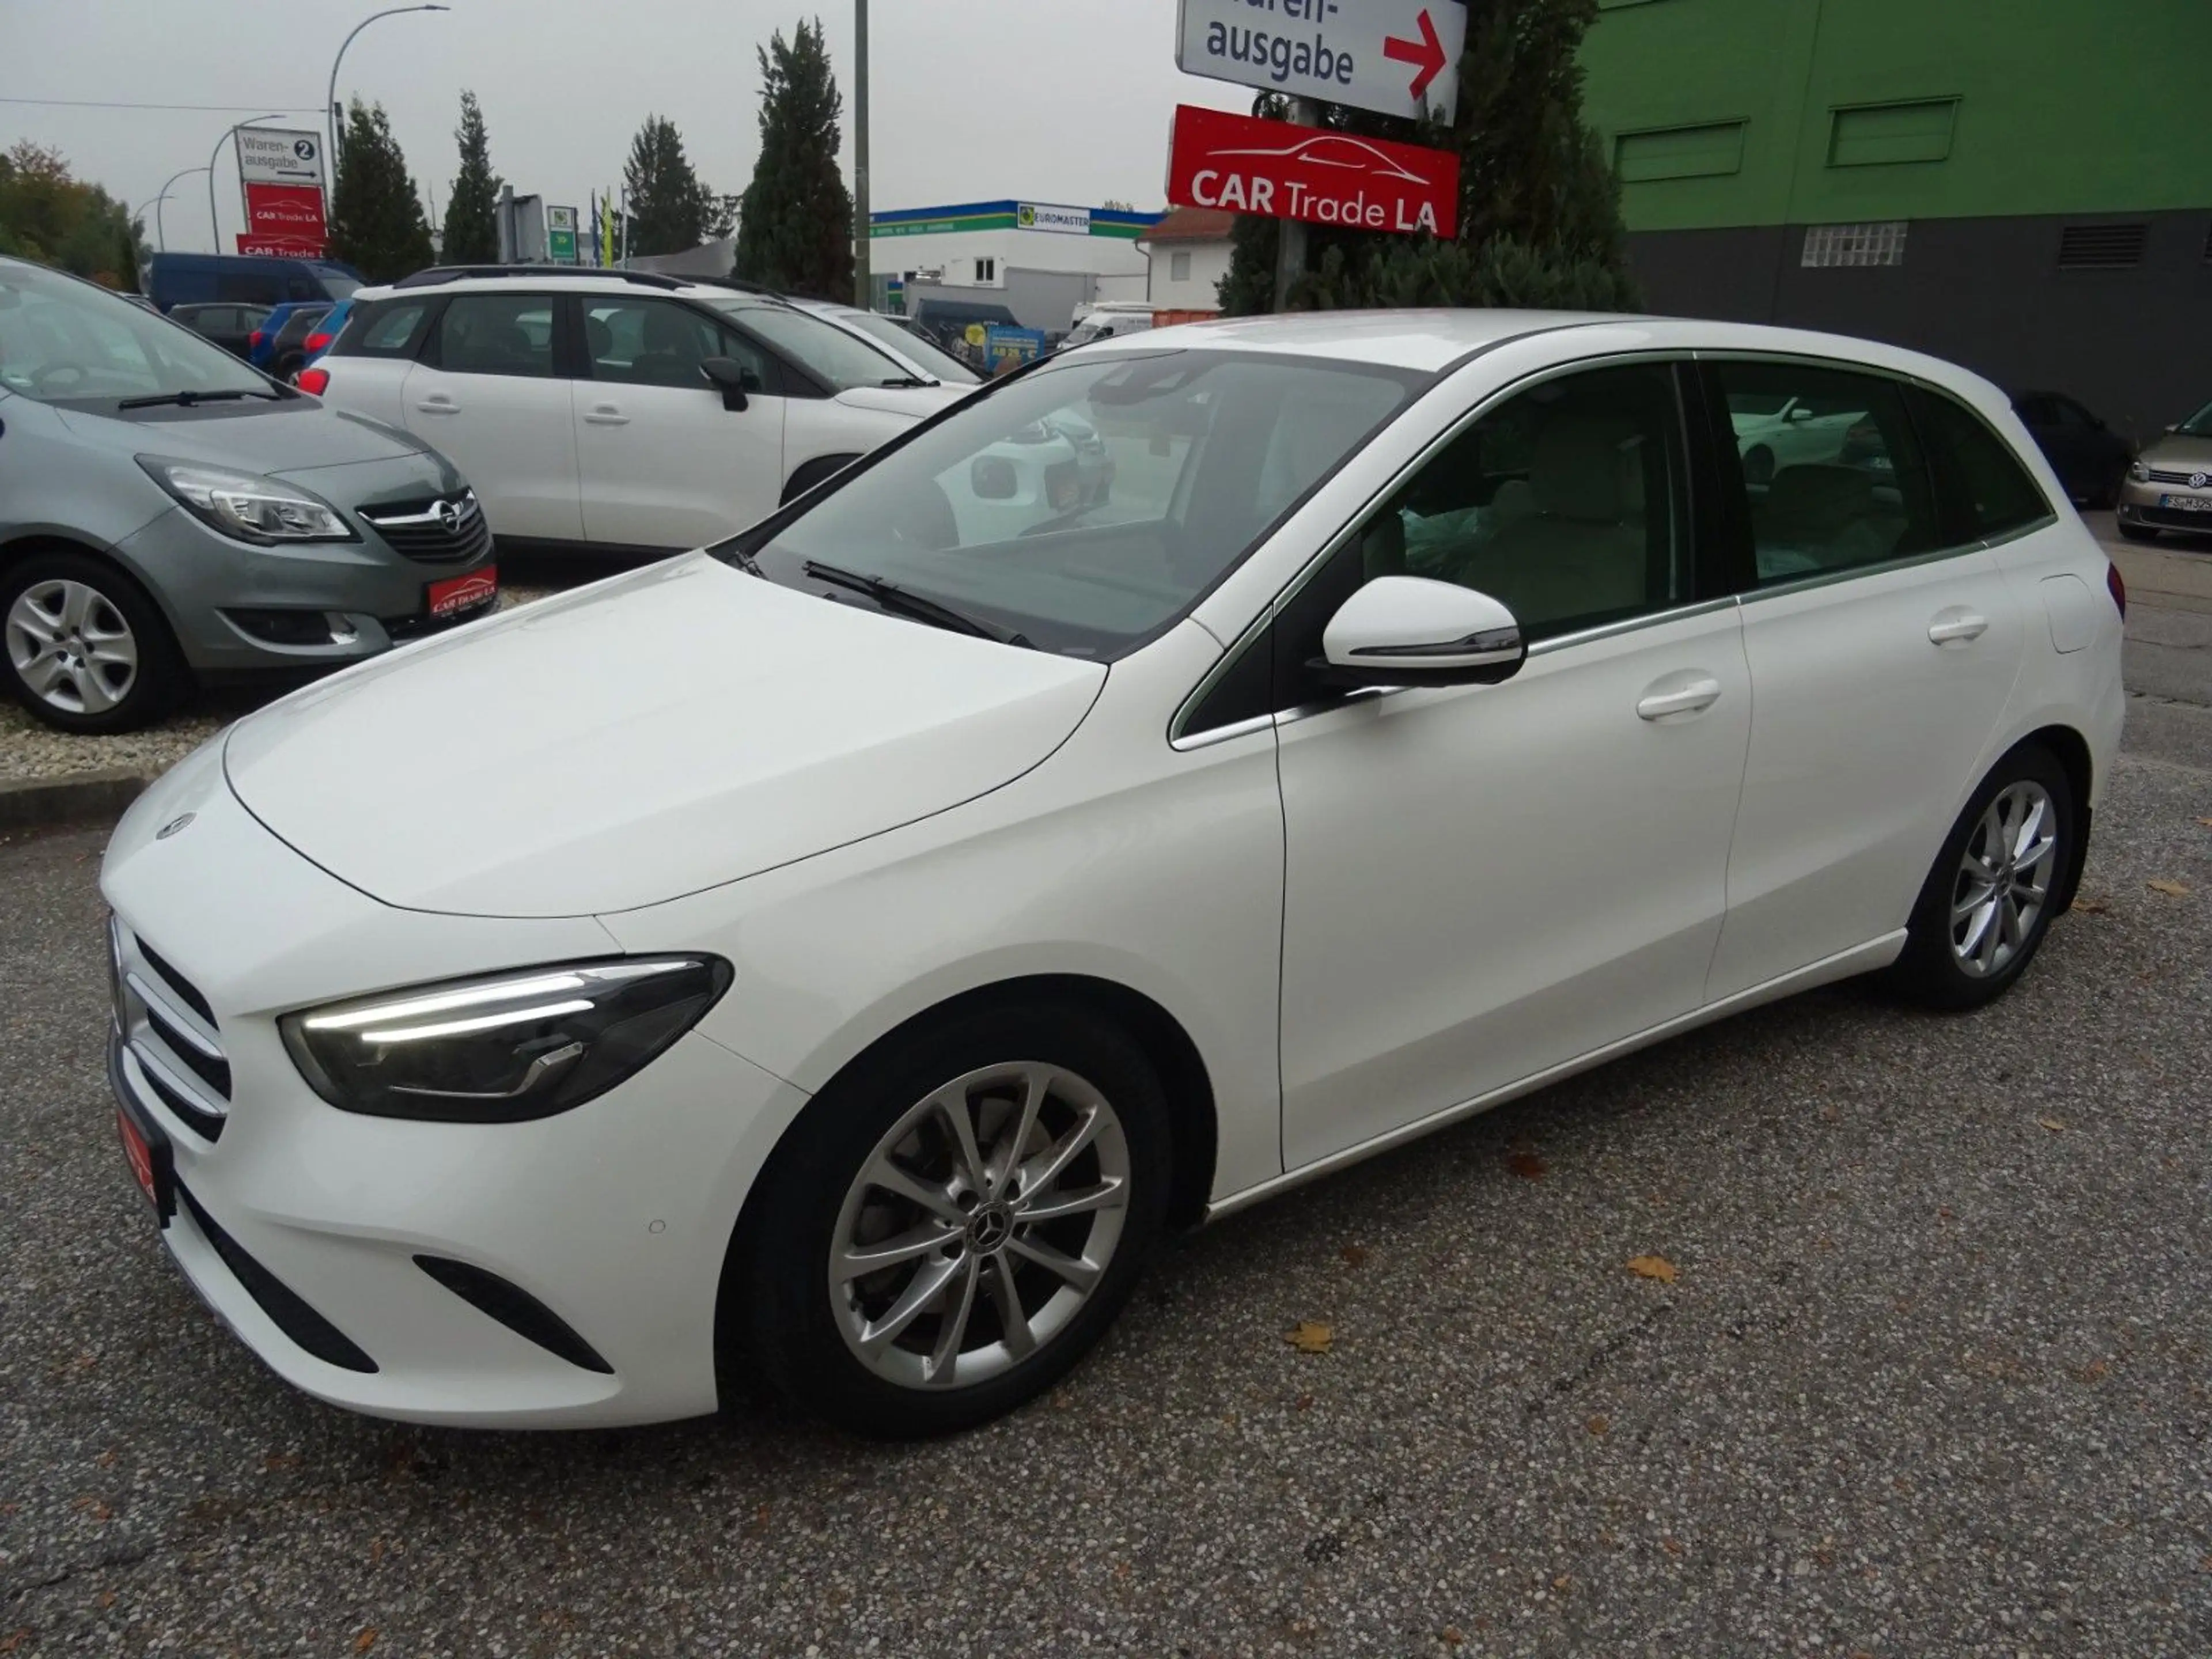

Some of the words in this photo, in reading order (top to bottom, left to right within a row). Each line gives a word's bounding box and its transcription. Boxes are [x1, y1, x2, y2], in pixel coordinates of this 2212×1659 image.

[1206, 21, 1353, 85] ausgabe
[243, 137, 289, 153] Waren-
[298, 142, 310, 158] 2
[245, 156, 298, 169] ausgabe
[1191, 169, 1274, 213] CAR
[1284, 181, 1385, 226] Trade
[1396, 198, 1438, 233] LA
[257, 211, 275, 219] CAR
[305, 214, 318, 222] LA
[1034, 211, 1089, 227] EUROMASTER
[245, 247, 273, 256] CAR
[278, 248, 316, 259] Trade
[433, 599, 456, 613] CAR
